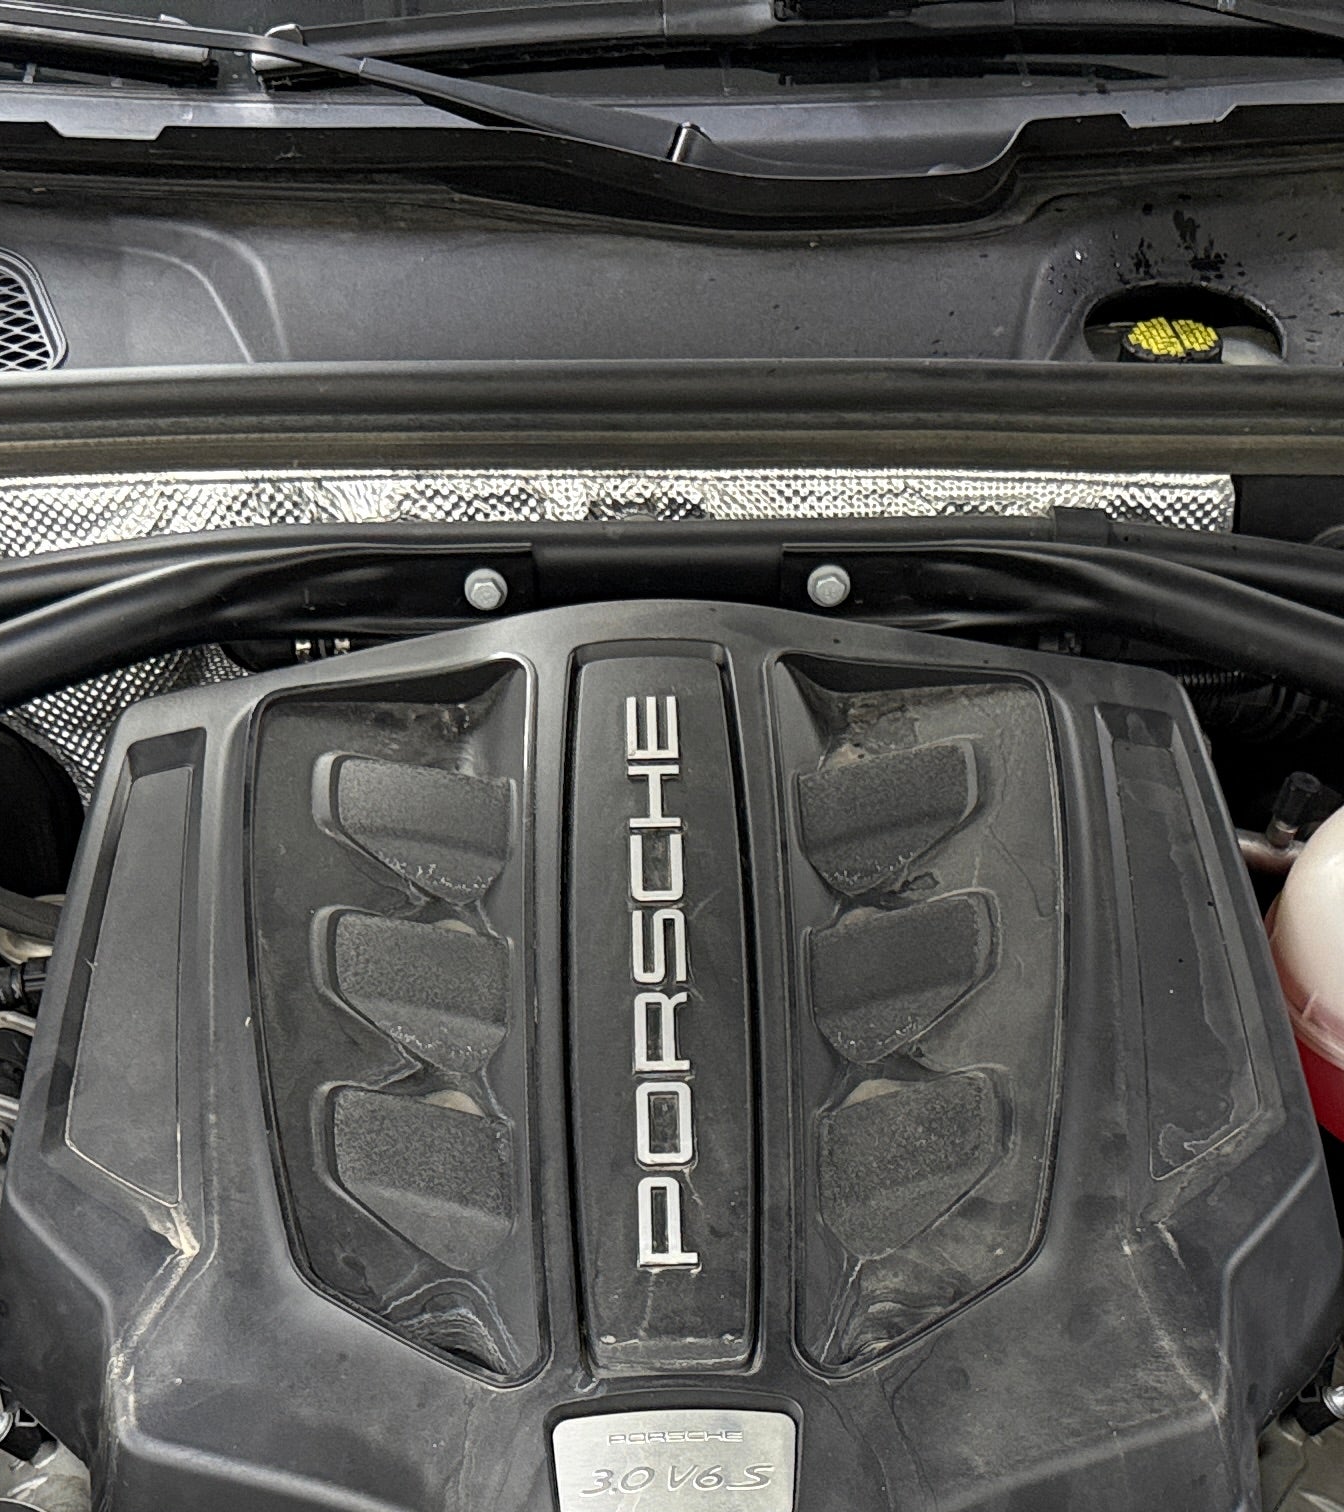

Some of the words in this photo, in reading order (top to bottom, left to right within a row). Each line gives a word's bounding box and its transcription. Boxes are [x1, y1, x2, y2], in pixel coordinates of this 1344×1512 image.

[626, 695, 698, 1267] PORSCHE
[607, 1431, 744, 1446] PORSCHE
[579, 1465, 655, 1498] 3.0
